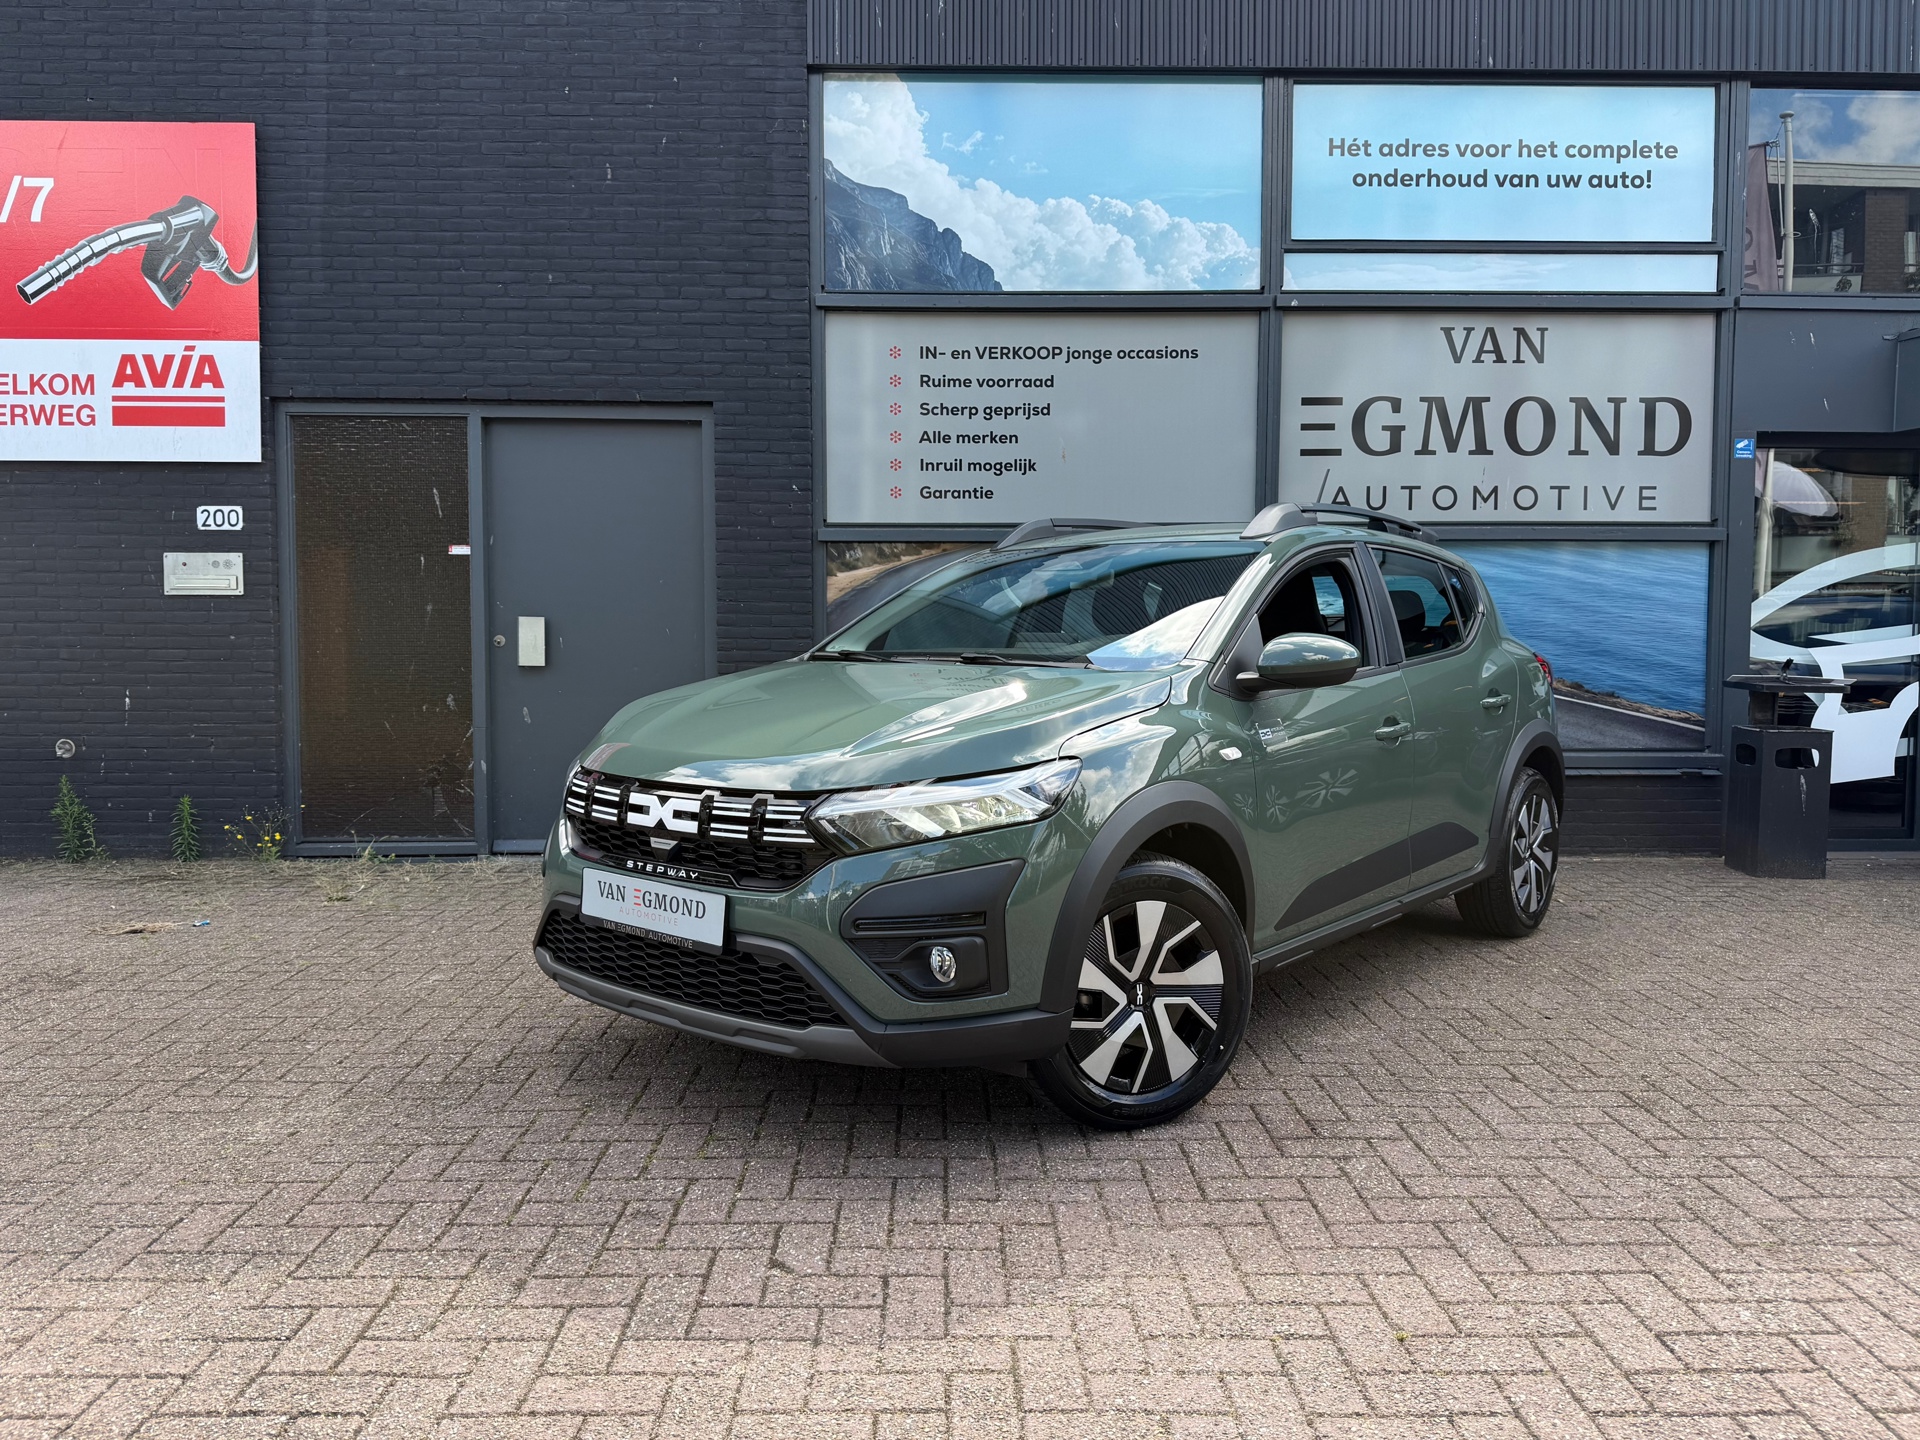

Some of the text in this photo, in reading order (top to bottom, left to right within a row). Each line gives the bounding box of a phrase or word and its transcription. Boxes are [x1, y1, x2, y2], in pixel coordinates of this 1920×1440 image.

[1328, 136, 1679, 164] Hét adres voor het complete
[1352, 168, 1652, 189] onderhoud van uw auto!
[919, 345, 1199, 364] IN- en VERKOOP jonge occasions
[1440, 326, 1549, 364] VAN
[919, 374, 1055, 388] Ruime voorraad
[919, 402, 1051, 420] Scherp geprijsd
[1300, 395, 1693, 457] EGMOND
[919, 430, 1019, 444] Alle merken
[920, 458, 1037, 476] Inruil mogelijk
[919, 485, 994, 500] Garantie
[1330, 485, 1657, 511] AUTOMOTIVE
[200, 508, 240, 528] 200
[626, 860, 698, 879] STEPWAY
[597, 880, 706, 919] VAN EGMOND
[619, 906, 679, 927] AUTOMOTIVE
[603, 920, 616, 931] VAN
[648, 931, 693, 949] AUTOMOTIVE
